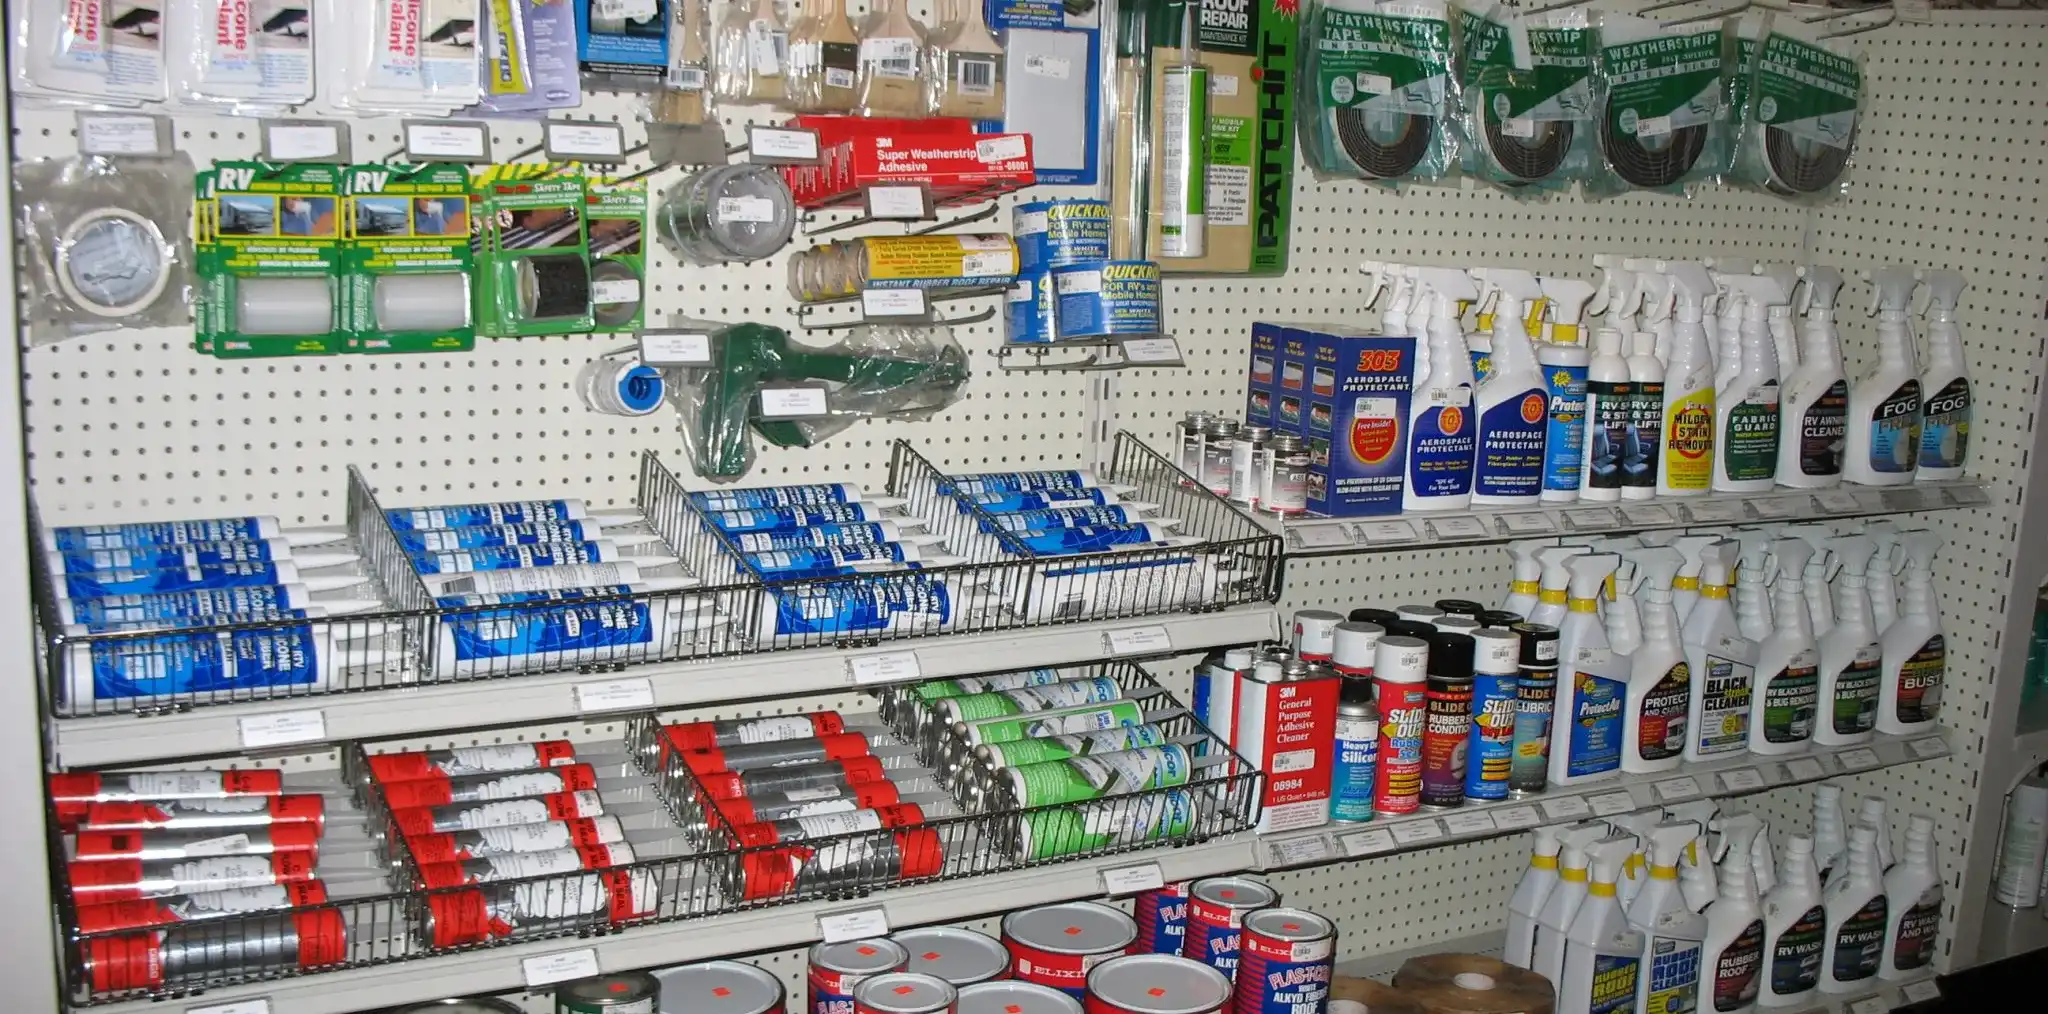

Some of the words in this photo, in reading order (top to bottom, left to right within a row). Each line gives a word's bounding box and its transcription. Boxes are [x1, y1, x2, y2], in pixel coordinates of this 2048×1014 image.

[1202, 10, 1248, 29] REPAIR
[1326, 10, 1443, 34] WEATHERSTRIP
[405, 0, 420, 56] icone
[1324, 26, 1362, 41] TAPE
[1609, 33, 1717, 60] WEATHERSTRIP
[1767, 51, 1797, 68] TAPE
[1611, 59, 1649, 73] TAPE
[876, 137, 892, 148] 3M
[877, 150, 909, 162] Super
[910, 148, 977, 162] Weatherstrip
[879, 161, 928, 173] Adhesive
[218, 168, 256, 191] RV
[354, 171, 389, 192] RV
[1049, 221, 1069, 230] FOR
[1103, 282, 1124, 291] FOR
[1103, 290, 1134, 300] Mobile
[1357, 350, 1400, 371] 303
[1343, 383, 1409, 392] PROTECTANT
[1602, 401, 1617, 409] RV
[1632, 401, 1648, 410] RV
[1884, 399, 1917, 418] FOG
[1930, 398, 1965, 415] FOG
[1732, 414, 1777, 423] FABRIC
[1804, 416, 1819, 426] RV
[1734, 422, 1775, 431] GUARD
[1489, 431, 1542, 439] AEROSPACE
[1421, 437, 1472, 446] AEROSPACE
[1485, 441, 1543, 449] PROTECTANT
[1417, 444, 1473, 454] PROTECTANT
[1707, 676, 1747, 692] BLACK
[1846, 680, 1864, 689] BLACK
[1904, 675, 1942, 690] BUST
[1280, 686, 1297, 698] 3M
[1767, 688, 1777, 697] RV
[1777, 686, 1799, 696] BLACK
[1842, 691, 1856, 699] BUG
[1279, 699, 1312, 711] General
[1646, 692, 1689, 709] PROTECT
[1705, 696, 1749, 711] CLEANER
[1772, 698, 1788, 707] BUG
[1430, 701, 1465, 712] SLIDE
[1645, 708, 1659, 716] AND
[1278, 709, 1313, 723] Purpose
[1429, 714, 1466, 725] RUBBER
[1277, 721, 1315, 732] Adhesive
[1397, 722, 1425, 737] OUT
[1277, 732, 1310, 744] Cleaner
[1343, 740, 1369, 752] Heavy
[1903, 919, 1917, 929] RV
[1840, 934, 1855, 945] RV
[1901, 929, 1921, 939] AND
[1778, 946, 1794, 957] RV
[1720, 951, 1760, 968] RUBBER
[1719, 965, 1748, 978] ROOF
[1273, 992, 1303, 1003] ALKYD
